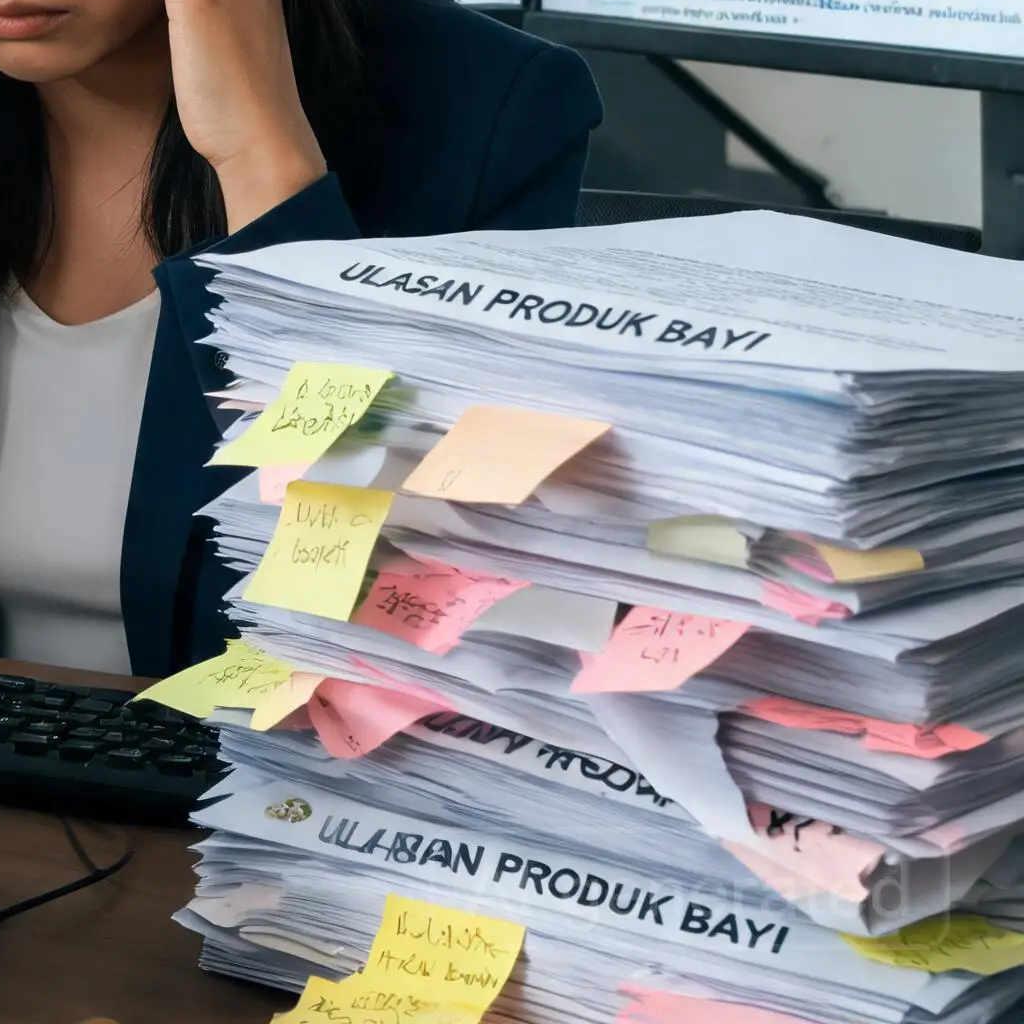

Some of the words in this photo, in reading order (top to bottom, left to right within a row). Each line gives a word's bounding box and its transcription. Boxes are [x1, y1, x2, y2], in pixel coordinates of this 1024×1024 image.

[339, 262, 484, 306] ULASAN
[483, 288, 658, 337] PRODUK
[655, 318, 771, 351] BAYI
[492, 851, 675, 926] PRODUK
[679, 901, 791, 955] BAYI
